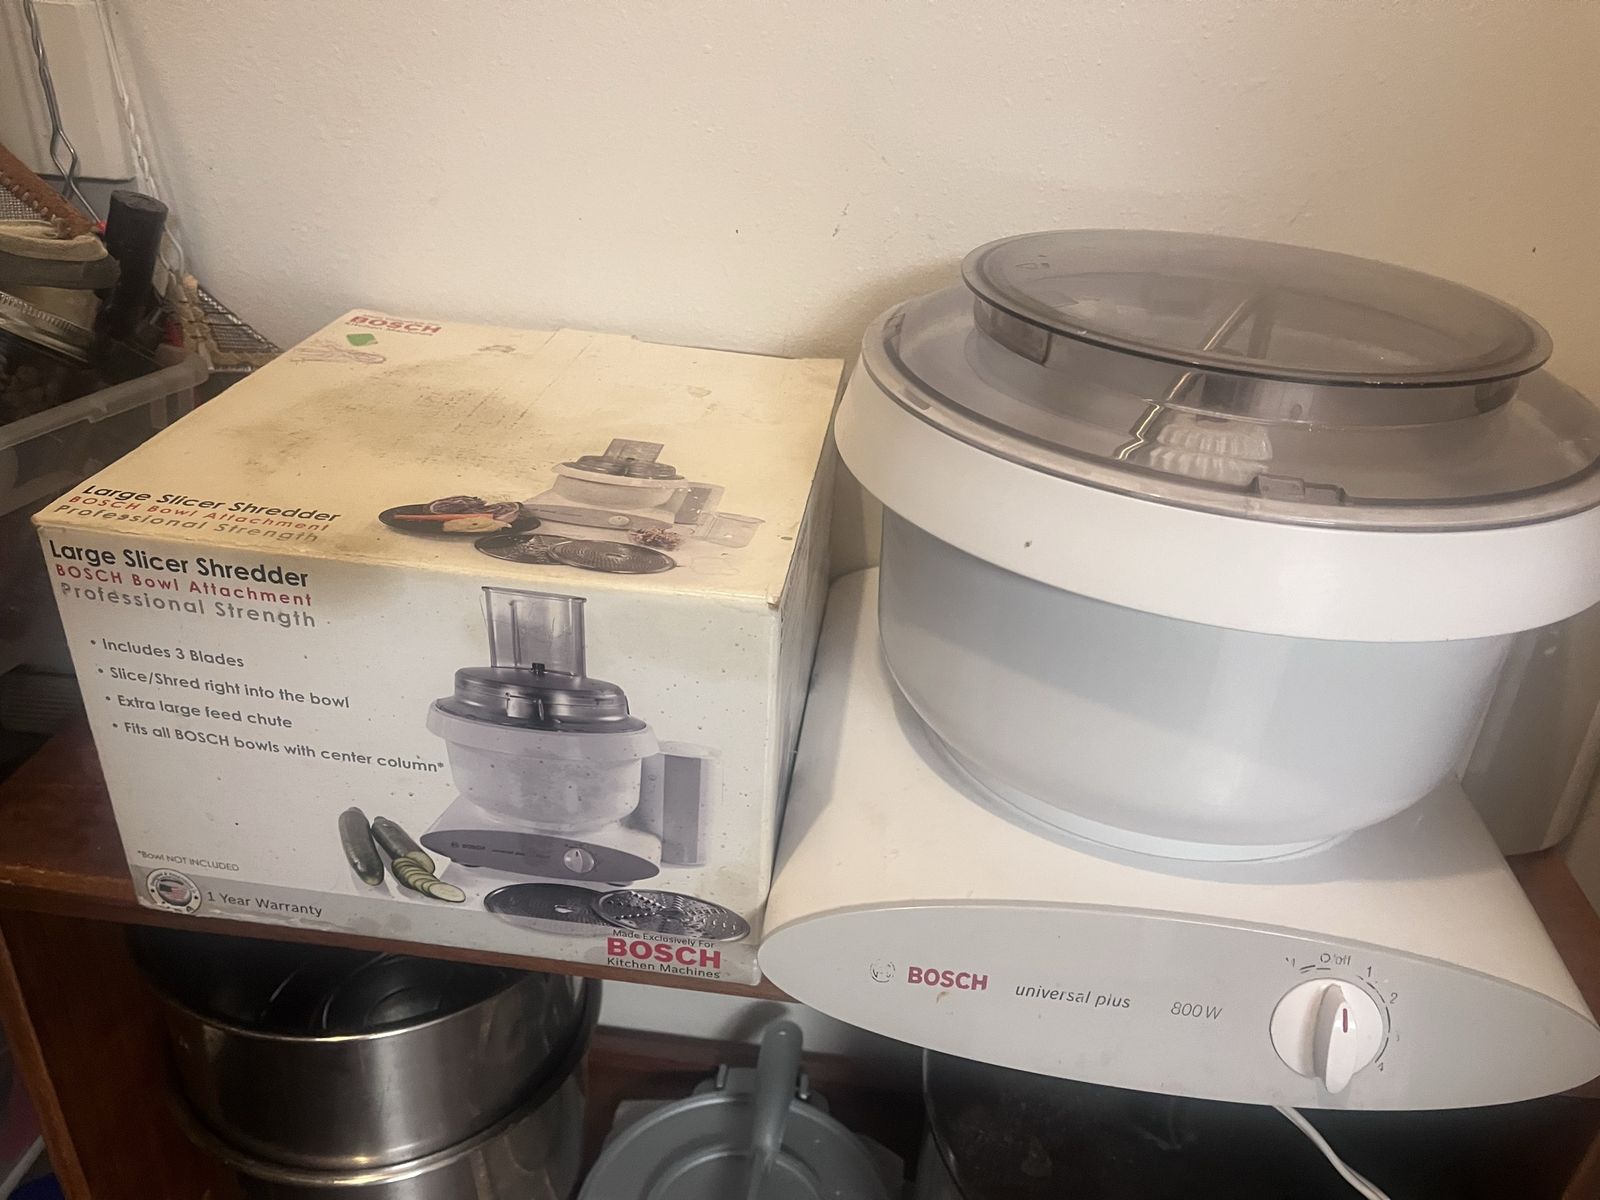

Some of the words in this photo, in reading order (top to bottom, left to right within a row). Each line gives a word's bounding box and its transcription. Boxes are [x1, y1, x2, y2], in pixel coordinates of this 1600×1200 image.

[350, 316, 442, 334] BOSCH
[69, 496, 140, 511] BOSCH
[147, 505, 197, 517] Bowl
[202, 512, 330, 532] Attachment
[83, 485, 151, 502] Large
[156, 493, 221, 510] Slicer
[228, 502, 341, 522] Shredder
[53, 504, 208, 529] Professional
[213, 523, 319, 543] Strength
[49, 540, 116, 567] Large
[123, 548, 189, 574] Slicer
[197, 557, 308, 588] Shredder
[56, 564, 123, 585] BOSCH
[132, 574, 179, 592] Bowl
[189, 580, 312, 607] Attachment
[60, 582, 205, 615] Professional
[215, 601, 316, 629] Strength
[102, 638, 171, 659] Includes
[175, 648, 186, 660] 3
[190, 650, 245, 668] Blades
[110, 667, 200, 691] Slice/Shred
[204, 678, 241, 697] right
[244, 684, 275, 699] into
[278, 689, 306, 704] the
[310, 694, 350, 709] bowl
[117, 695, 156, 711] Extra
[159, 700, 201, 719] large
[204, 706, 243, 723] feed
[246, 713, 293, 729] chute
[124, 722, 148, 736] Fits
[152, 726, 171, 740] all
[174, 729, 230, 747] BOSCH
[234, 737, 281, 754] bowls
[284, 744, 317, 759] with
[320, 750, 373, 766] center
[166, 855, 188, 864] NOT
[189, 858, 240, 872] INCLUDED
[207, 891, 216, 902] 1
[219, 893, 251, 907] Year
[255, 898, 323, 918] Warranty
[607, 936, 721, 969] BOSCH
[612, 929, 641, 939] Made
[643, 934, 696, 947] Exclusively
[698, 940, 715, 949] For
[607, 957, 655, 971] Kitchen
[659, 963, 721, 979] Machines
[907, 966, 988, 991] BOSCH
[1015, 984, 1092, 1005] universal
[1094, 993, 1131, 1009] plus
[1389, 992, 1399, 1005] 2
